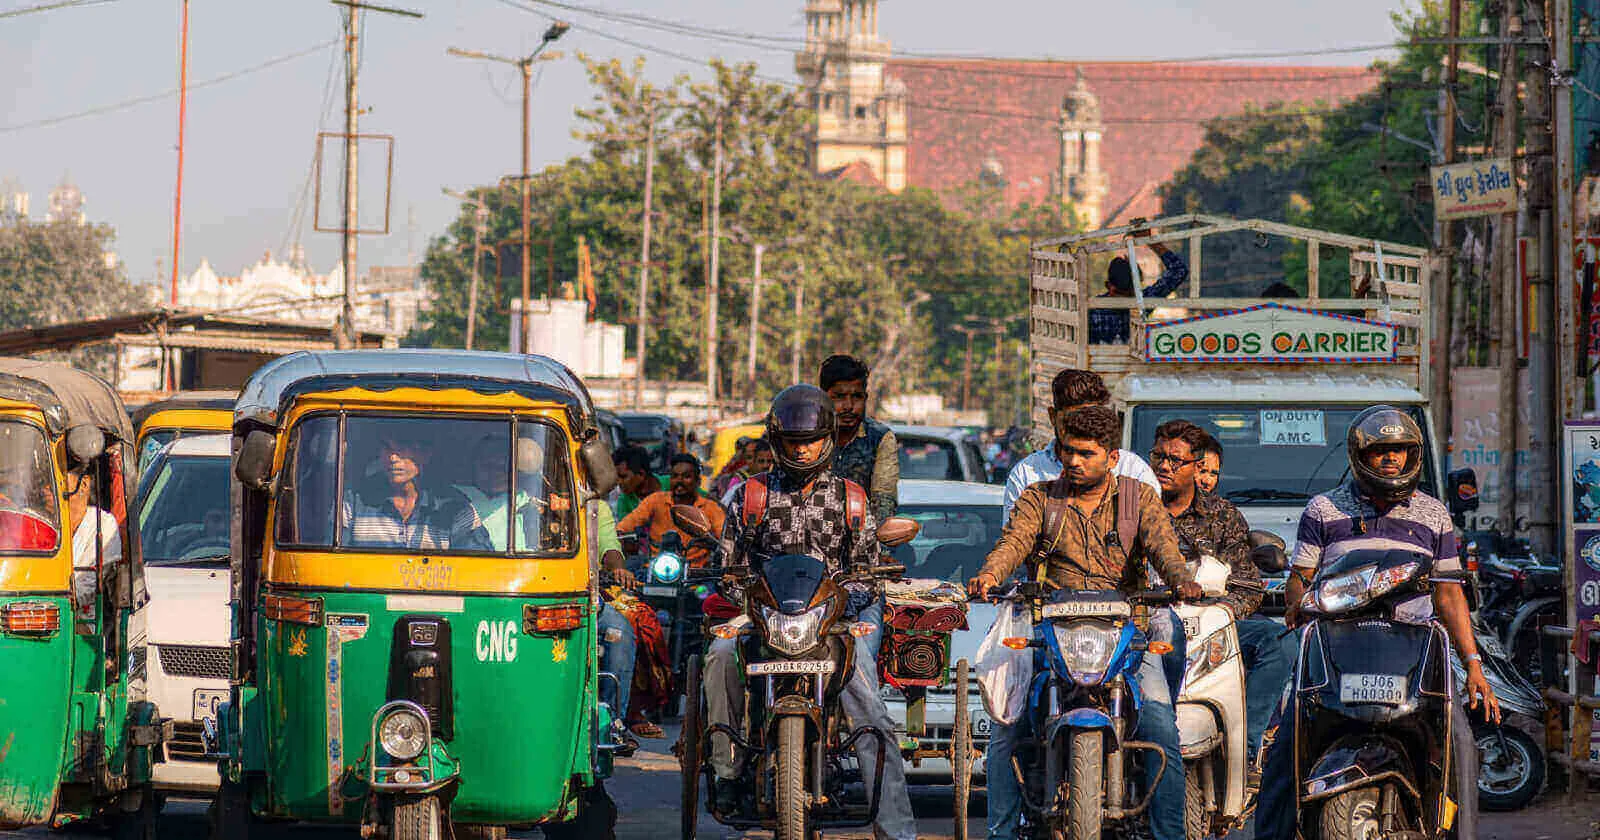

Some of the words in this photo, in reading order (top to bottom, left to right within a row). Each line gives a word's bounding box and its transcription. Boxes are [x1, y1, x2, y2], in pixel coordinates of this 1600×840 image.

[1155, 332, 1261, 354] GOODS
[1271, 332, 1387, 354] CARRIER
[1264, 411, 1282, 423] ON
[1286, 411, 1320, 422] DUTY
[1275, 431, 1312, 443] AMC
[1357, 620, 1393, 628] HONDA
[475, 619, 518, 662] CNG
[1361, 675, 1394, 688] GJ06
